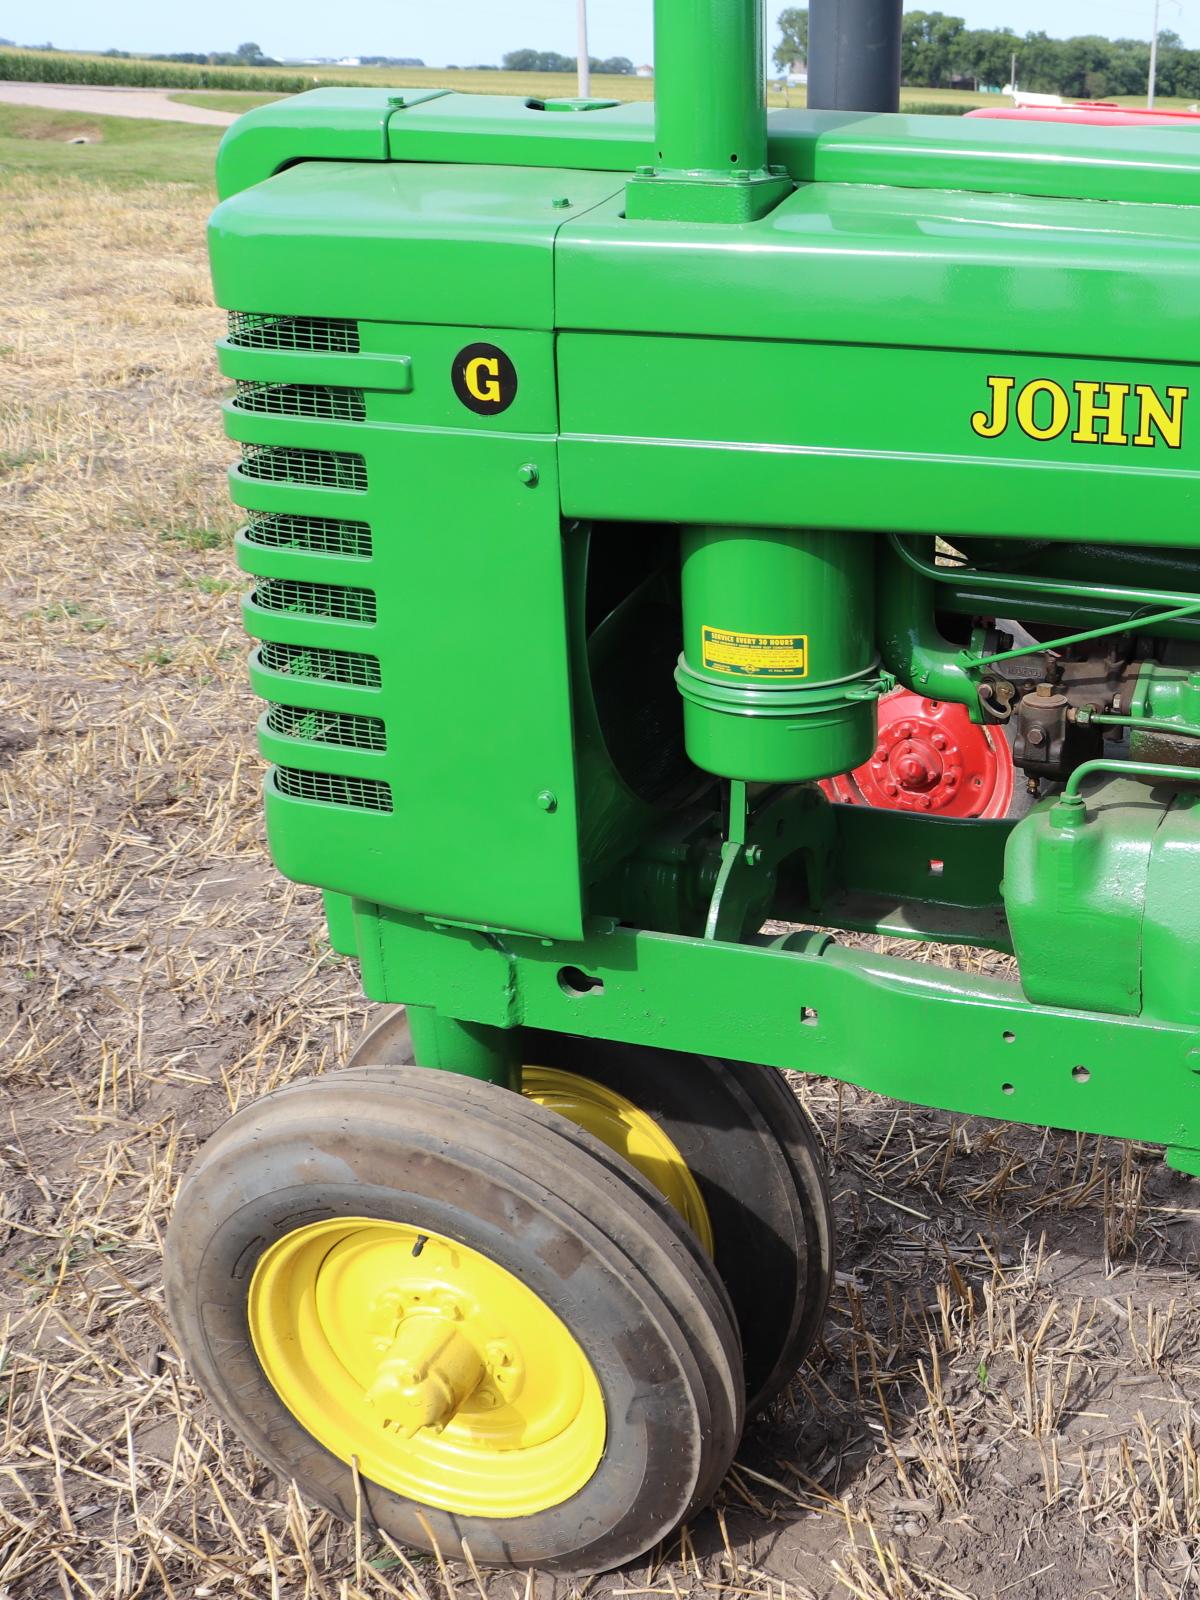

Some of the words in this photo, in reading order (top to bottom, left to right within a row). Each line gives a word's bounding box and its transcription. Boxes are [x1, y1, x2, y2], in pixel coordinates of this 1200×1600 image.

[465, 357, 501, 403] G
[970, 375, 1189, 449] JOHN
[711, 632, 735, 643] SERVICE
[736, 636, 756, 646] EVERY
